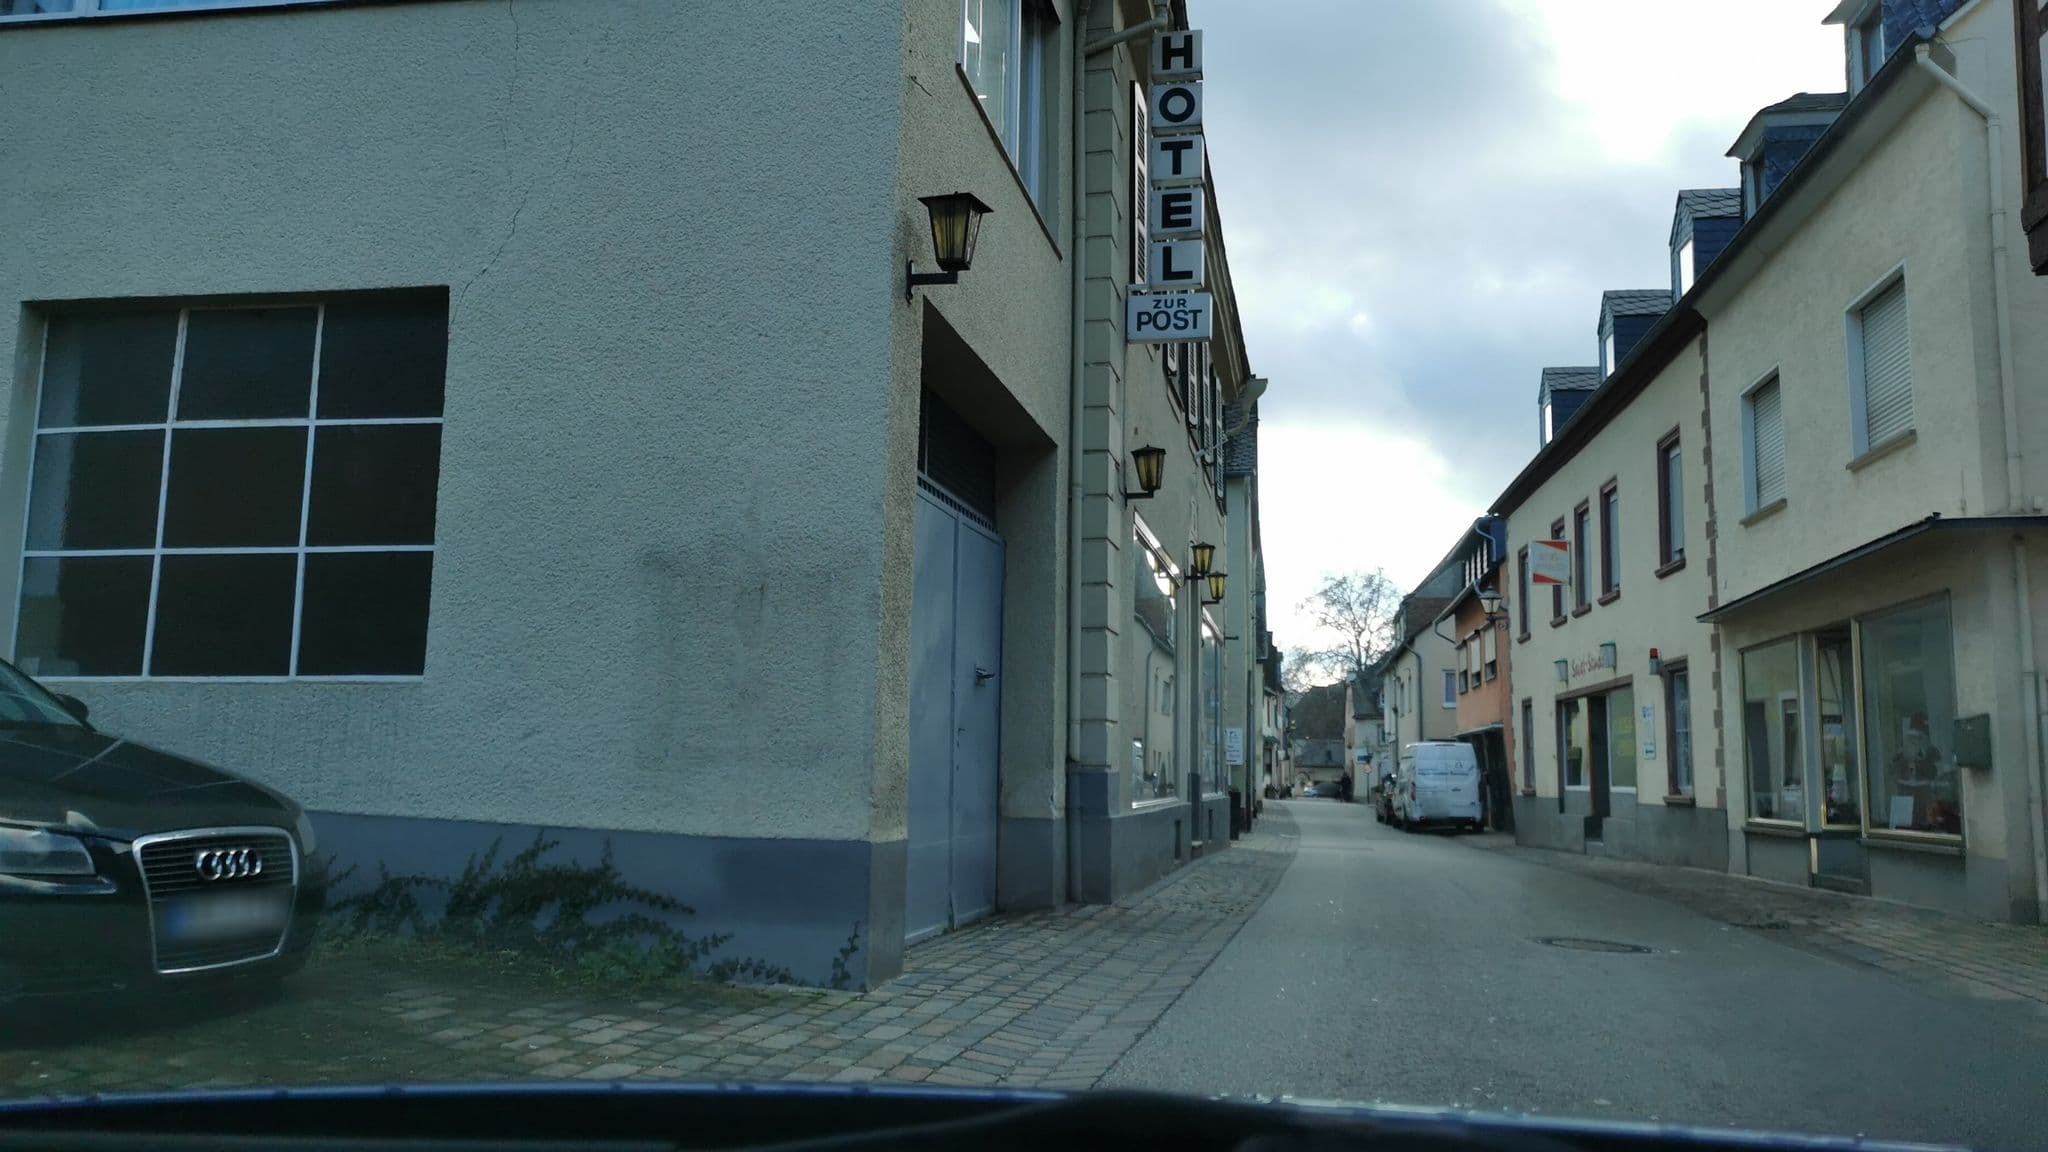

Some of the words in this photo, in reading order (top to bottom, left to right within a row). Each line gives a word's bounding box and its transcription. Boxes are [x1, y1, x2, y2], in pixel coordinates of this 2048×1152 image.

[1159, 34, 1195, 281] HOTEL
[1153, 298, 1187, 309] ZUR
[1137, 309, 1203, 331] POST
